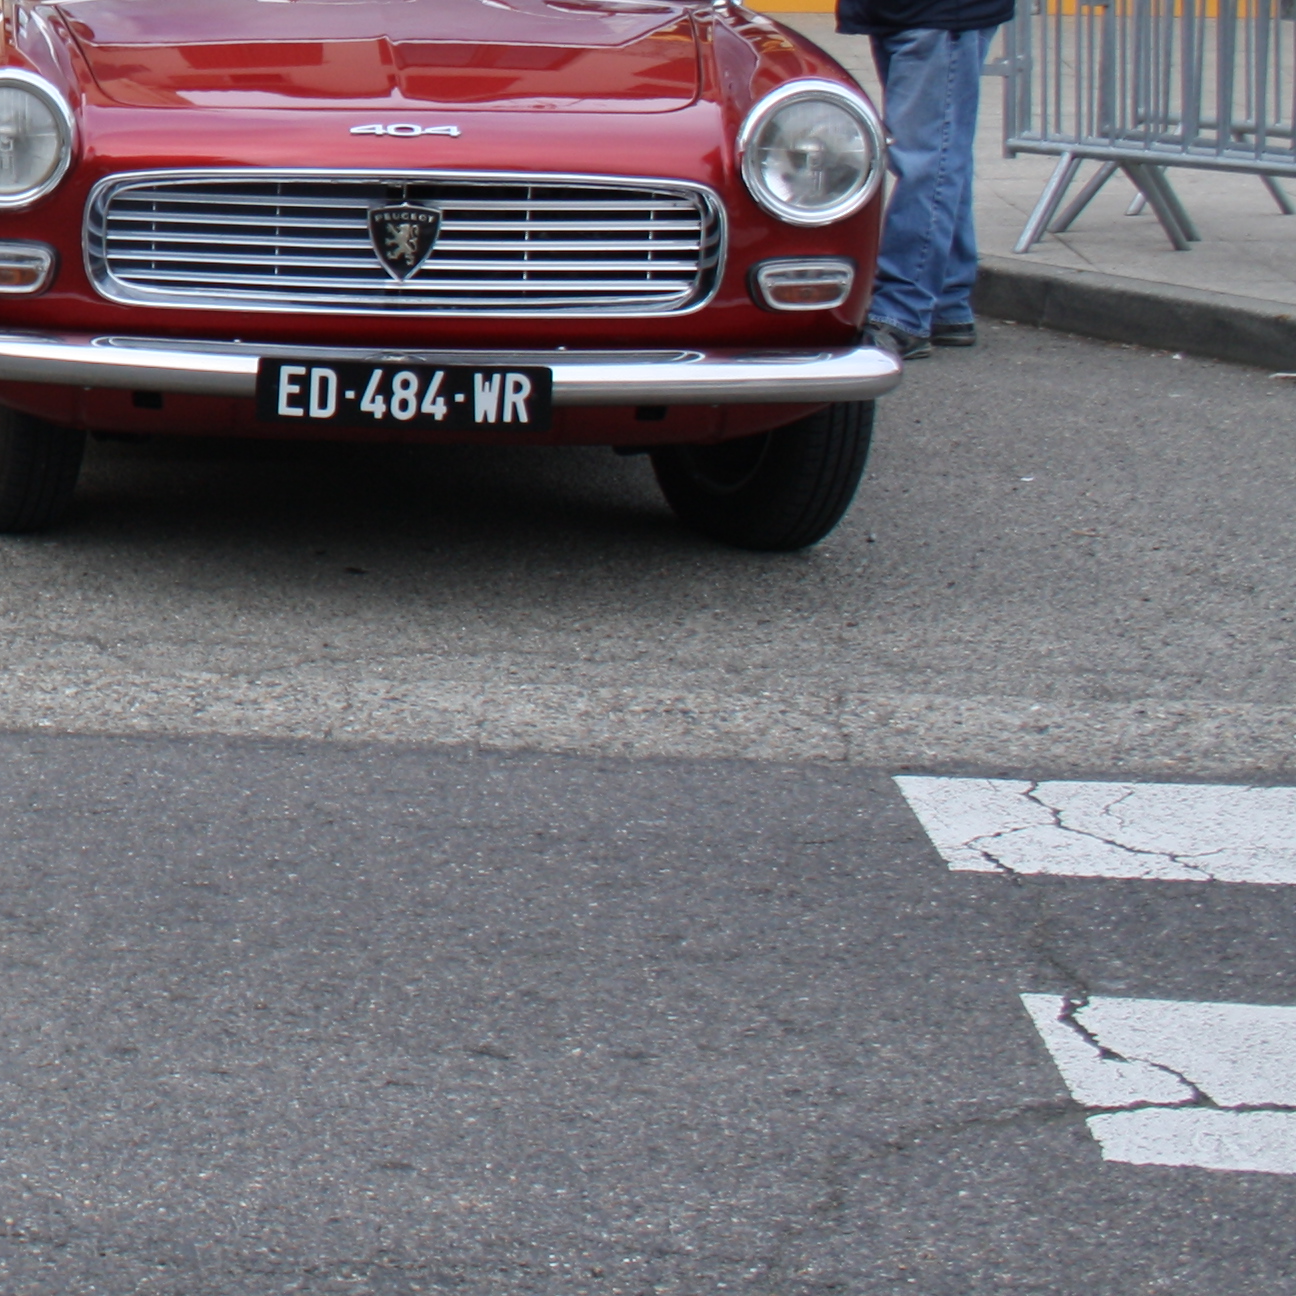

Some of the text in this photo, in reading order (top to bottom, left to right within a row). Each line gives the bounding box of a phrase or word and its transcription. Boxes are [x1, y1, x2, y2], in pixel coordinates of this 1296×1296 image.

[350, 124, 461, 137] 404
[374, 212, 435, 223] PEUGEOT
[278, 365, 532, 424] ED-484-WR
